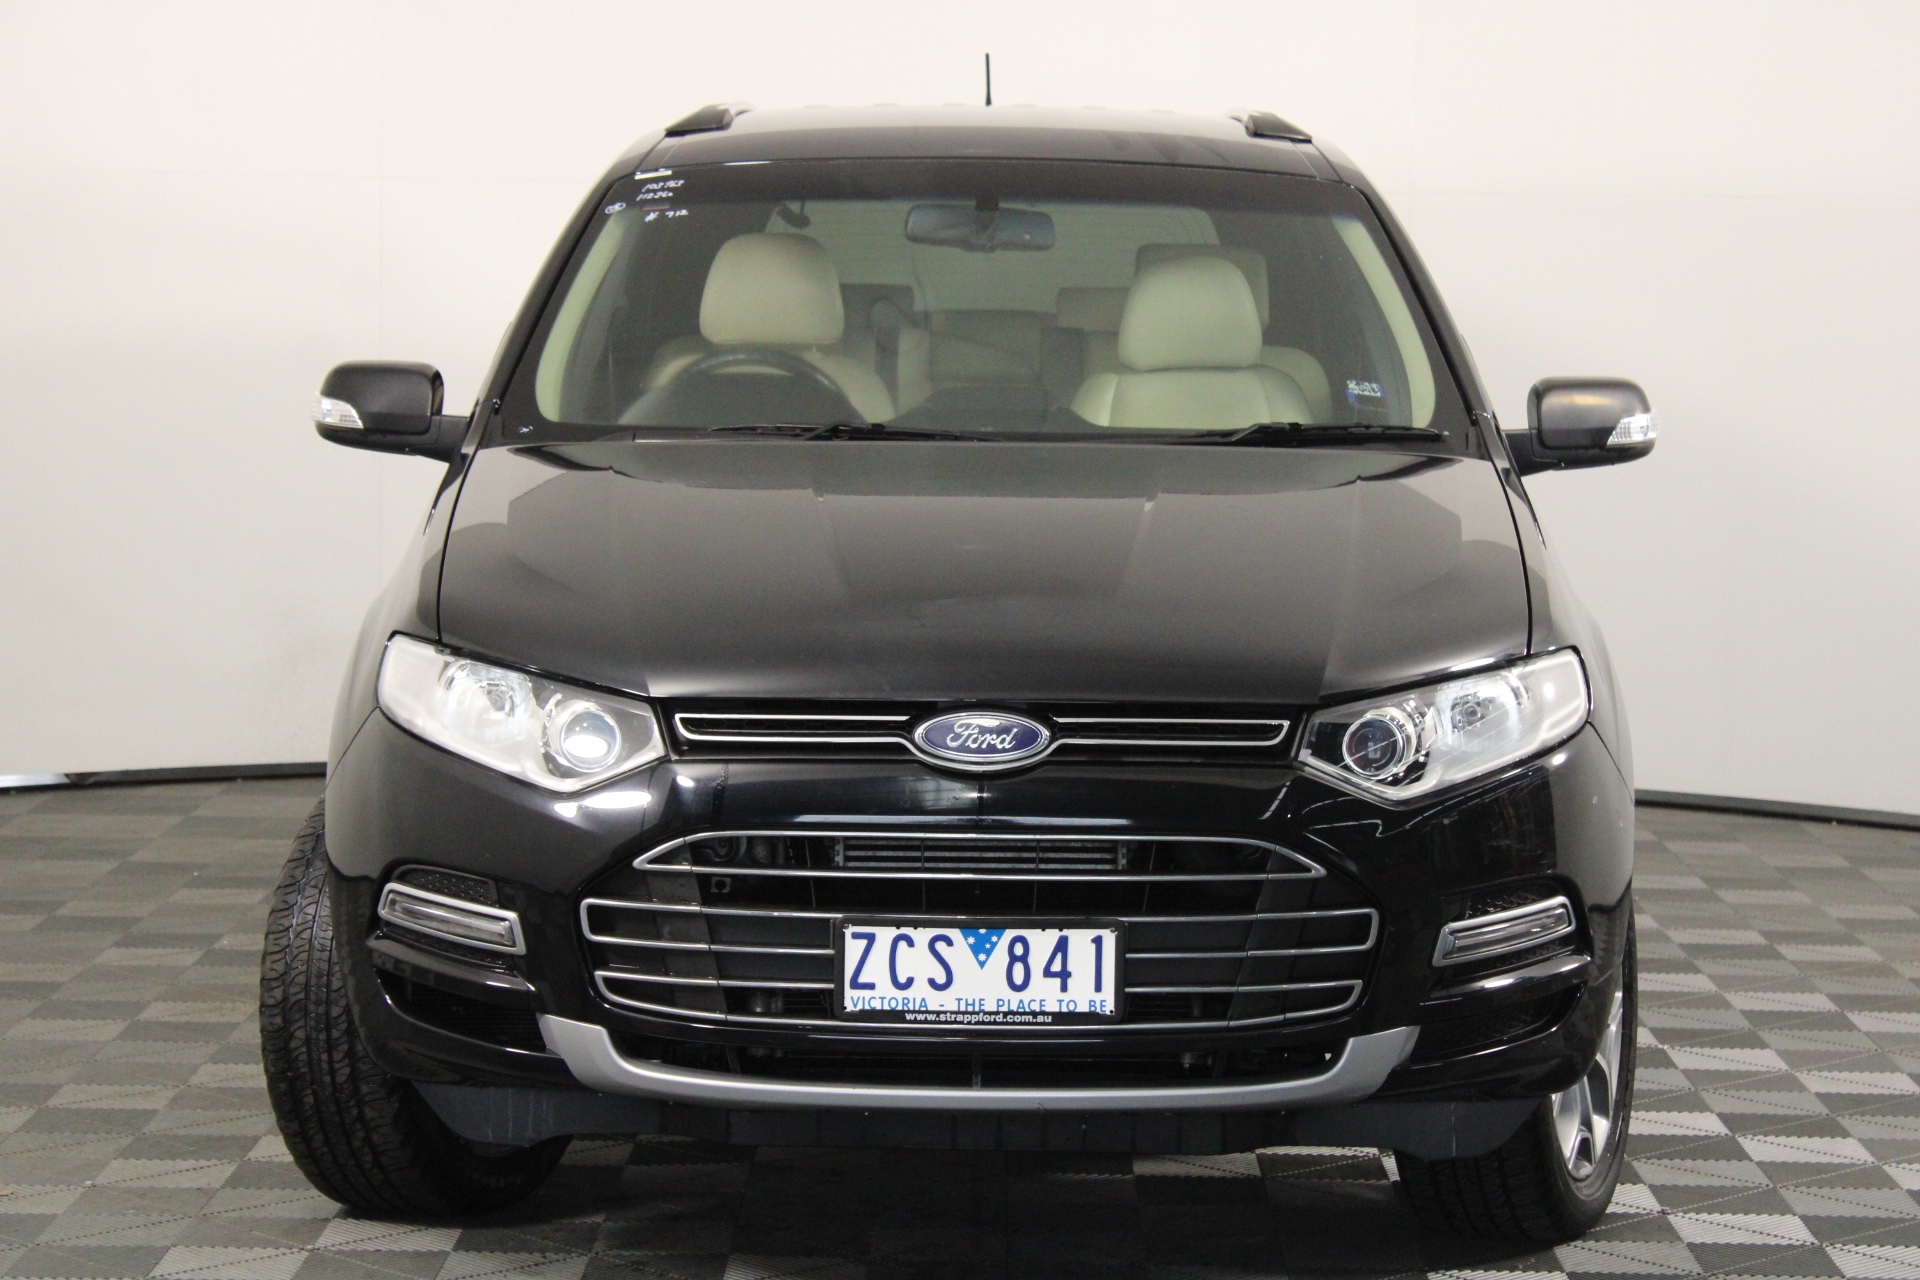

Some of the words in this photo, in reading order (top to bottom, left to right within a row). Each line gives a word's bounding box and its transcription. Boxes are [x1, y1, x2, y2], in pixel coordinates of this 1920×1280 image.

[946, 718, 1018, 749] Ford
[849, 931, 954, 991] ZCS
[1005, 935, 1103, 993] 841
[850, 996, 929, 1011] VICTORIA
[955, 998, 986, 1011] THE
[996, 998, 1047, 1013] PLACE
[1056, 999, 1078, 1013] TO
[1089, 1000, 1107, 1013] BE
[905, 1012, 1053, 1024] www.strappford.com.au
